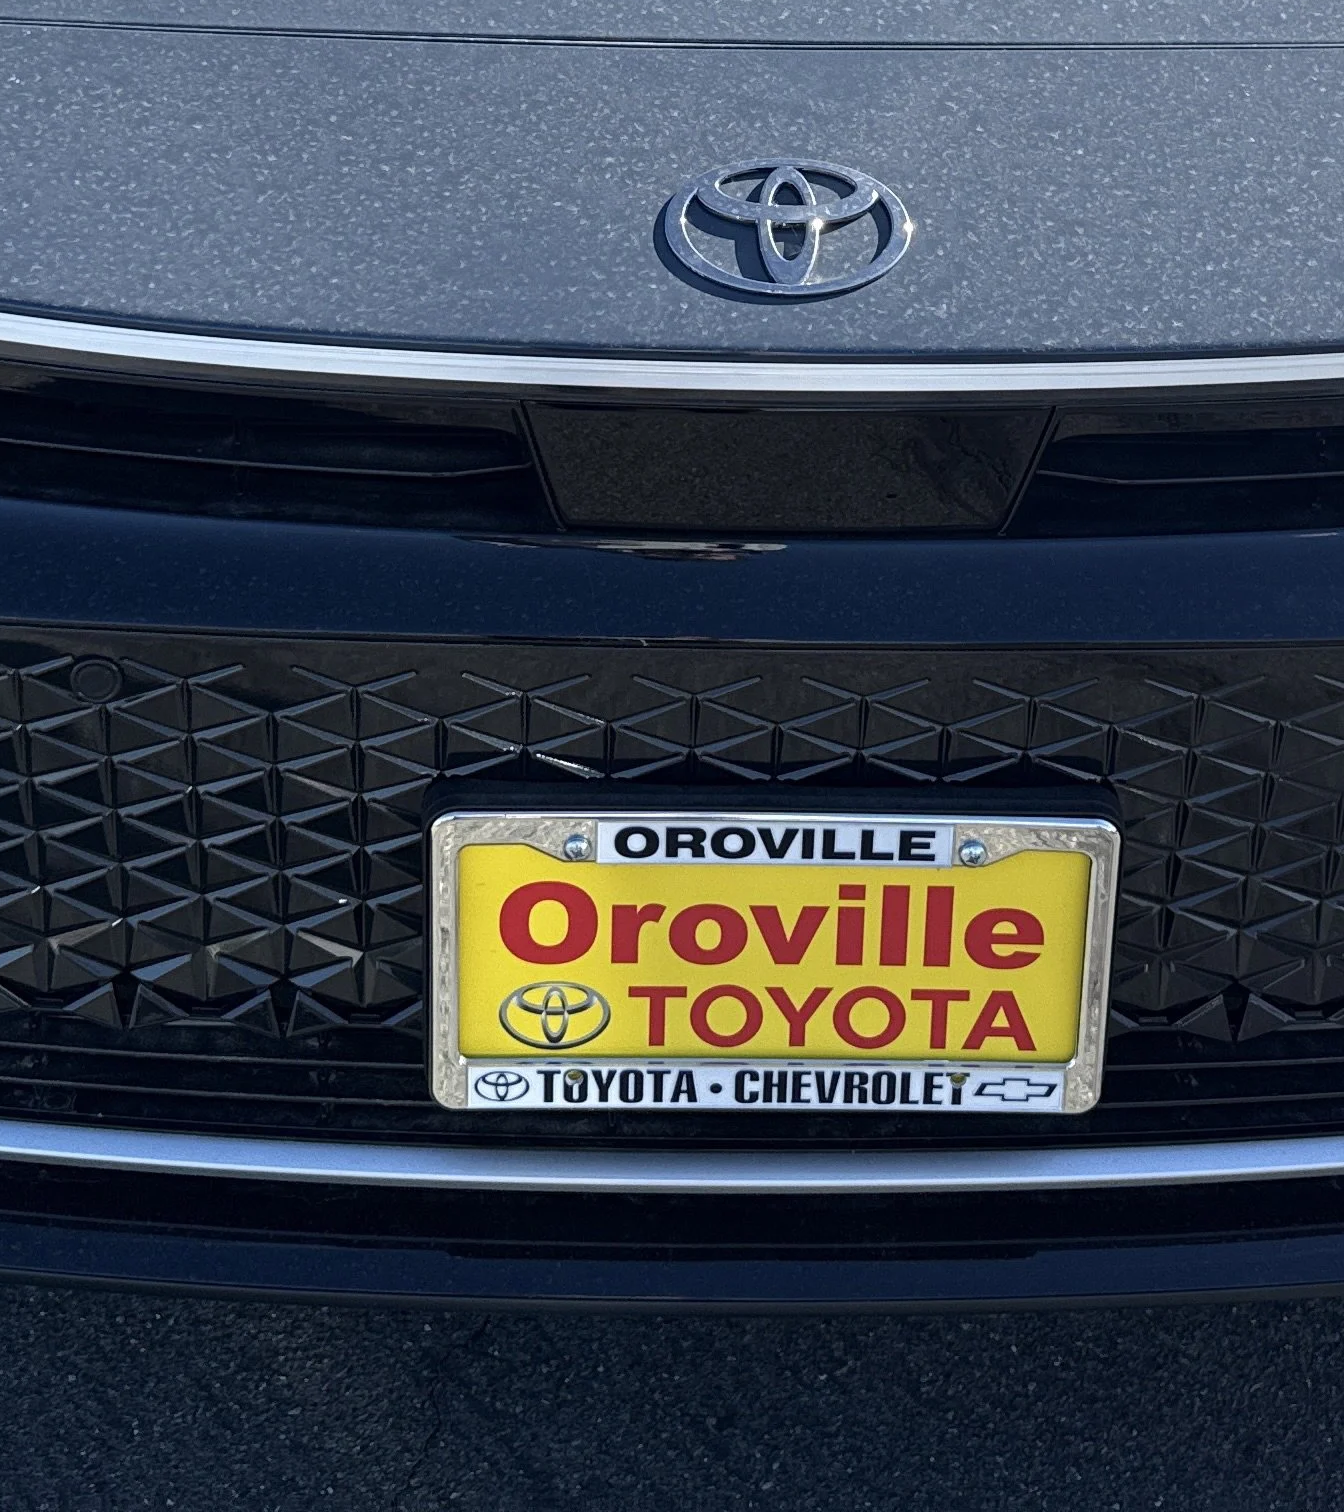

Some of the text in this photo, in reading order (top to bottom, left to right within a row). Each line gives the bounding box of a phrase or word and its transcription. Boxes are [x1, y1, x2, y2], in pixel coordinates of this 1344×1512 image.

[613, 826, 937, 862] OROVILLE
[499, 880, 1045, 970] Oroville
[627, 985, 1038, 1052] TOYOTA
[536, 1069, 971, 1105] TOYOTA CHEVROLET
